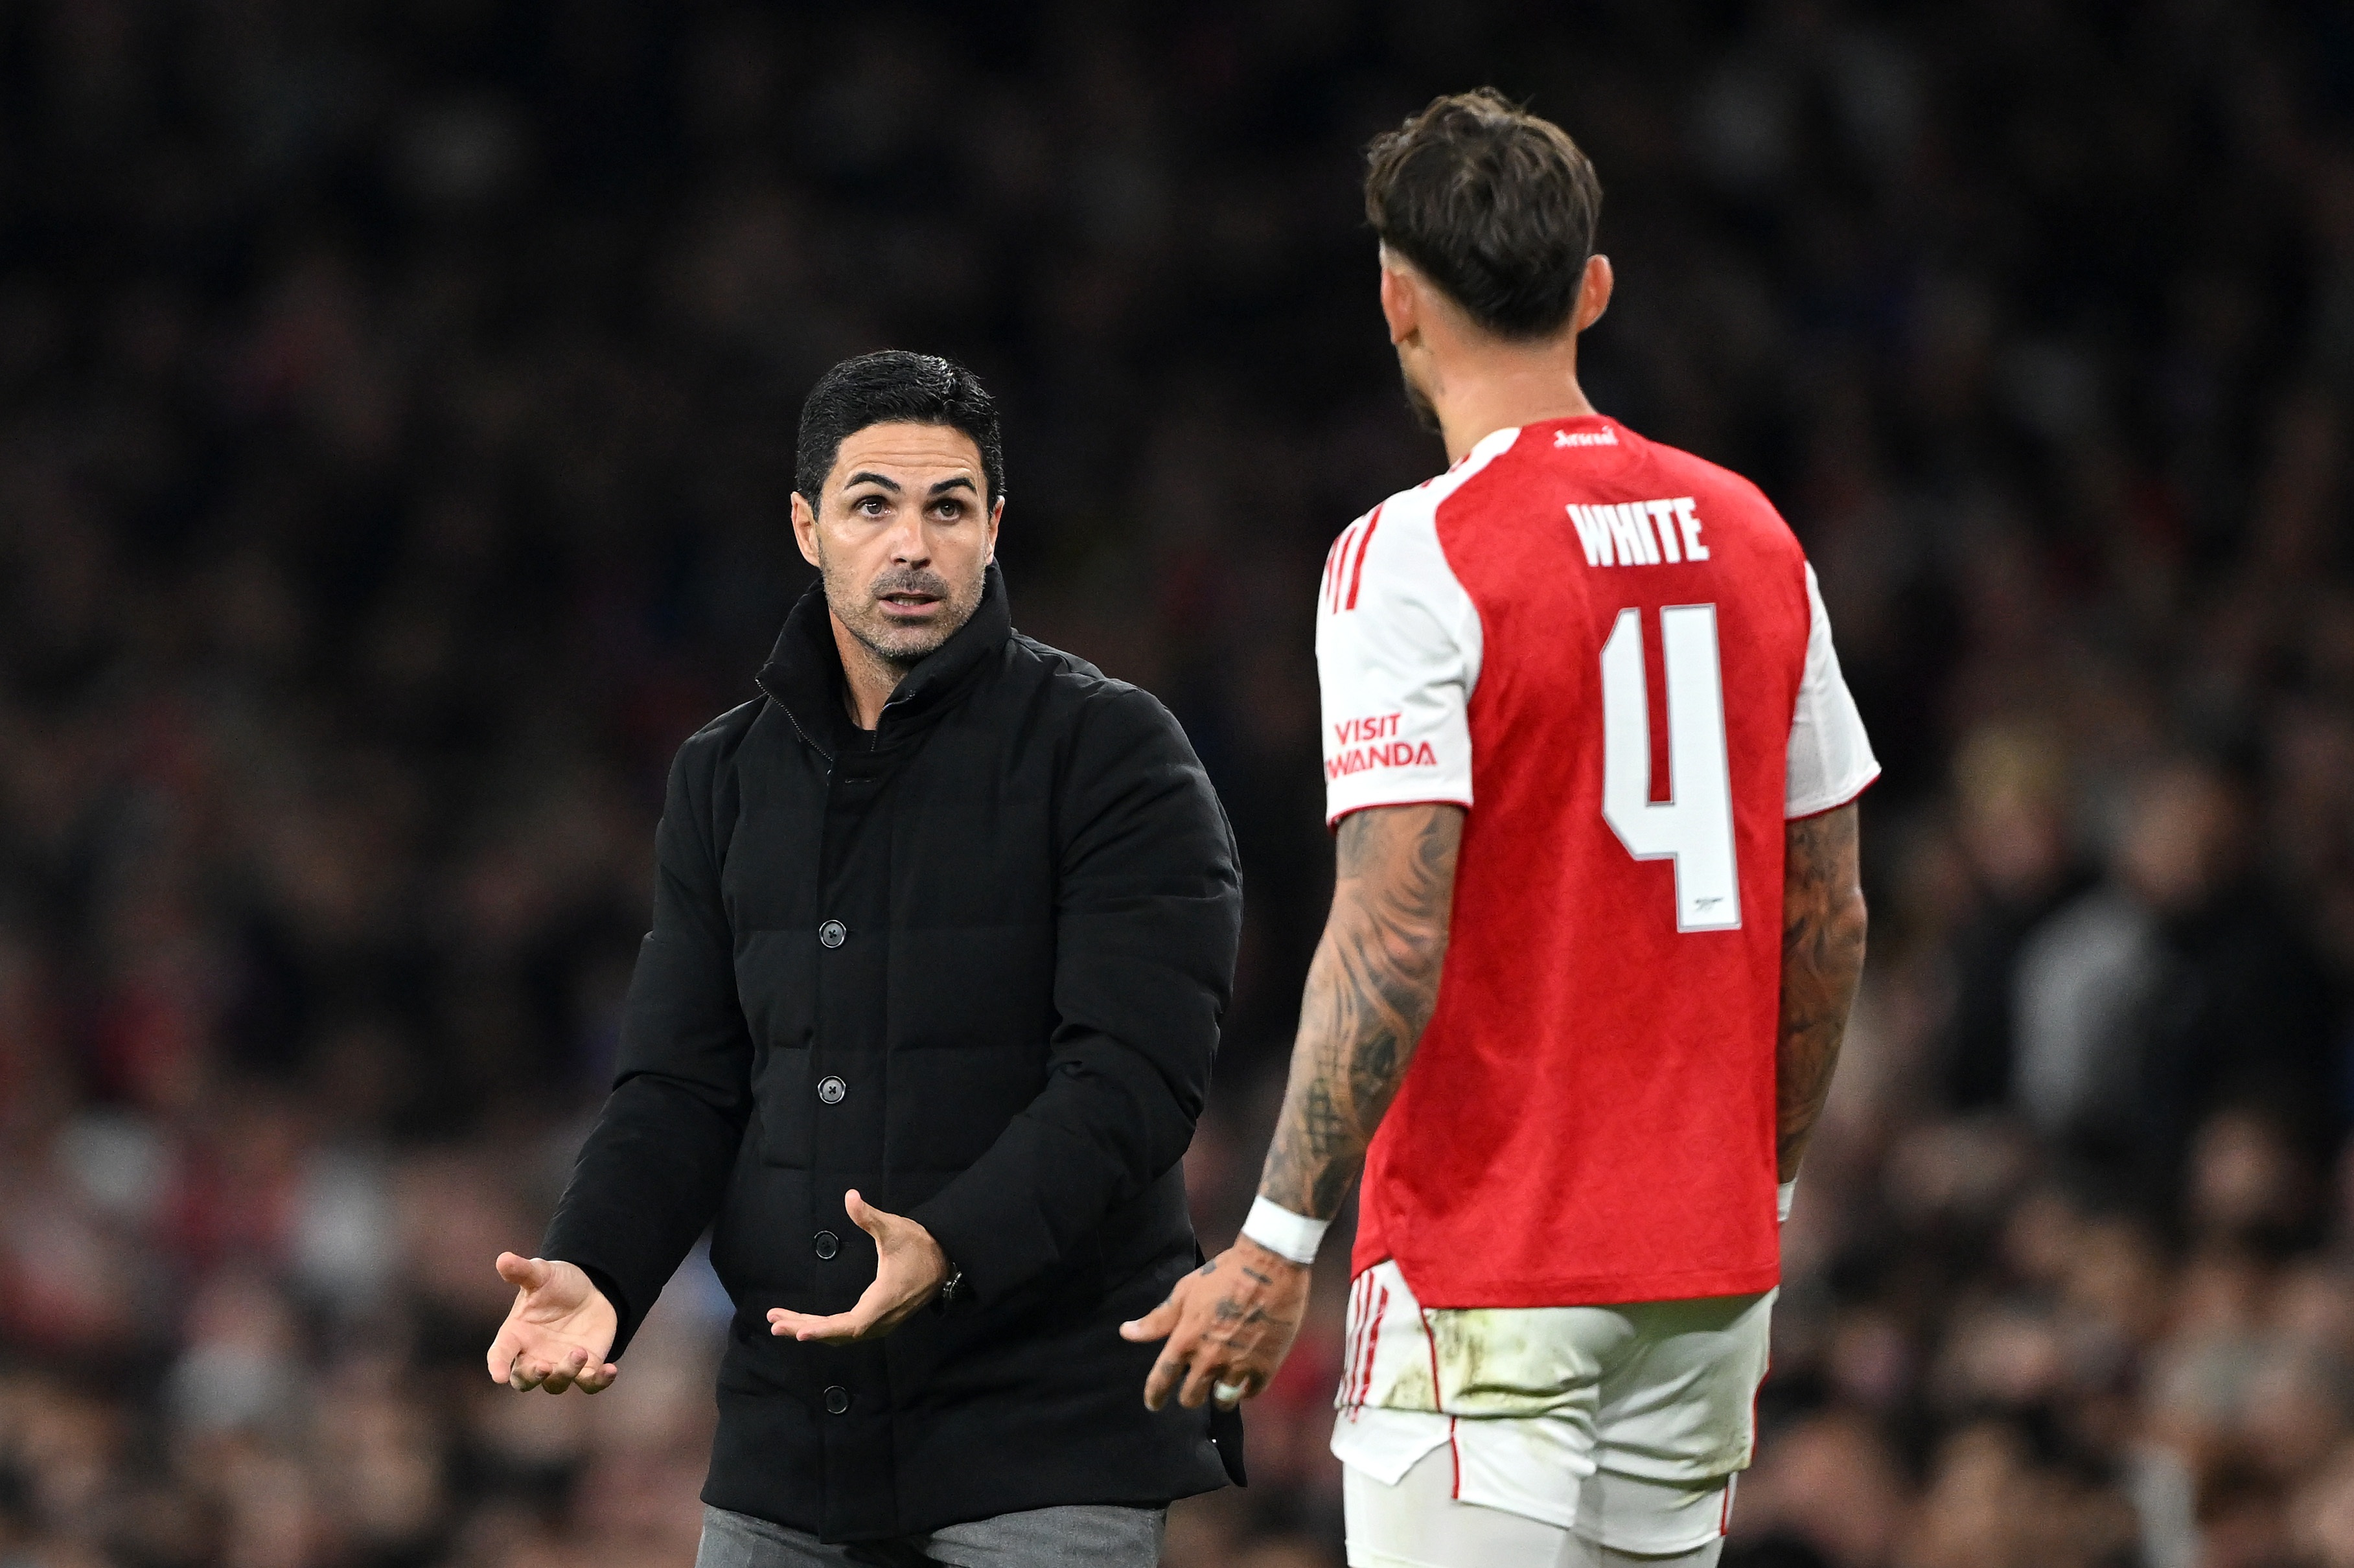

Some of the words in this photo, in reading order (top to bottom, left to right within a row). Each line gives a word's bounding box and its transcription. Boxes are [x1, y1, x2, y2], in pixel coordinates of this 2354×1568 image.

[1565, 496, 1710, 567] WHITE
[1335, 713, 1402, 745] VISIT
[1326, 741, 1437, 779] WANDA
[1600, 603, 1742, 933] 4
